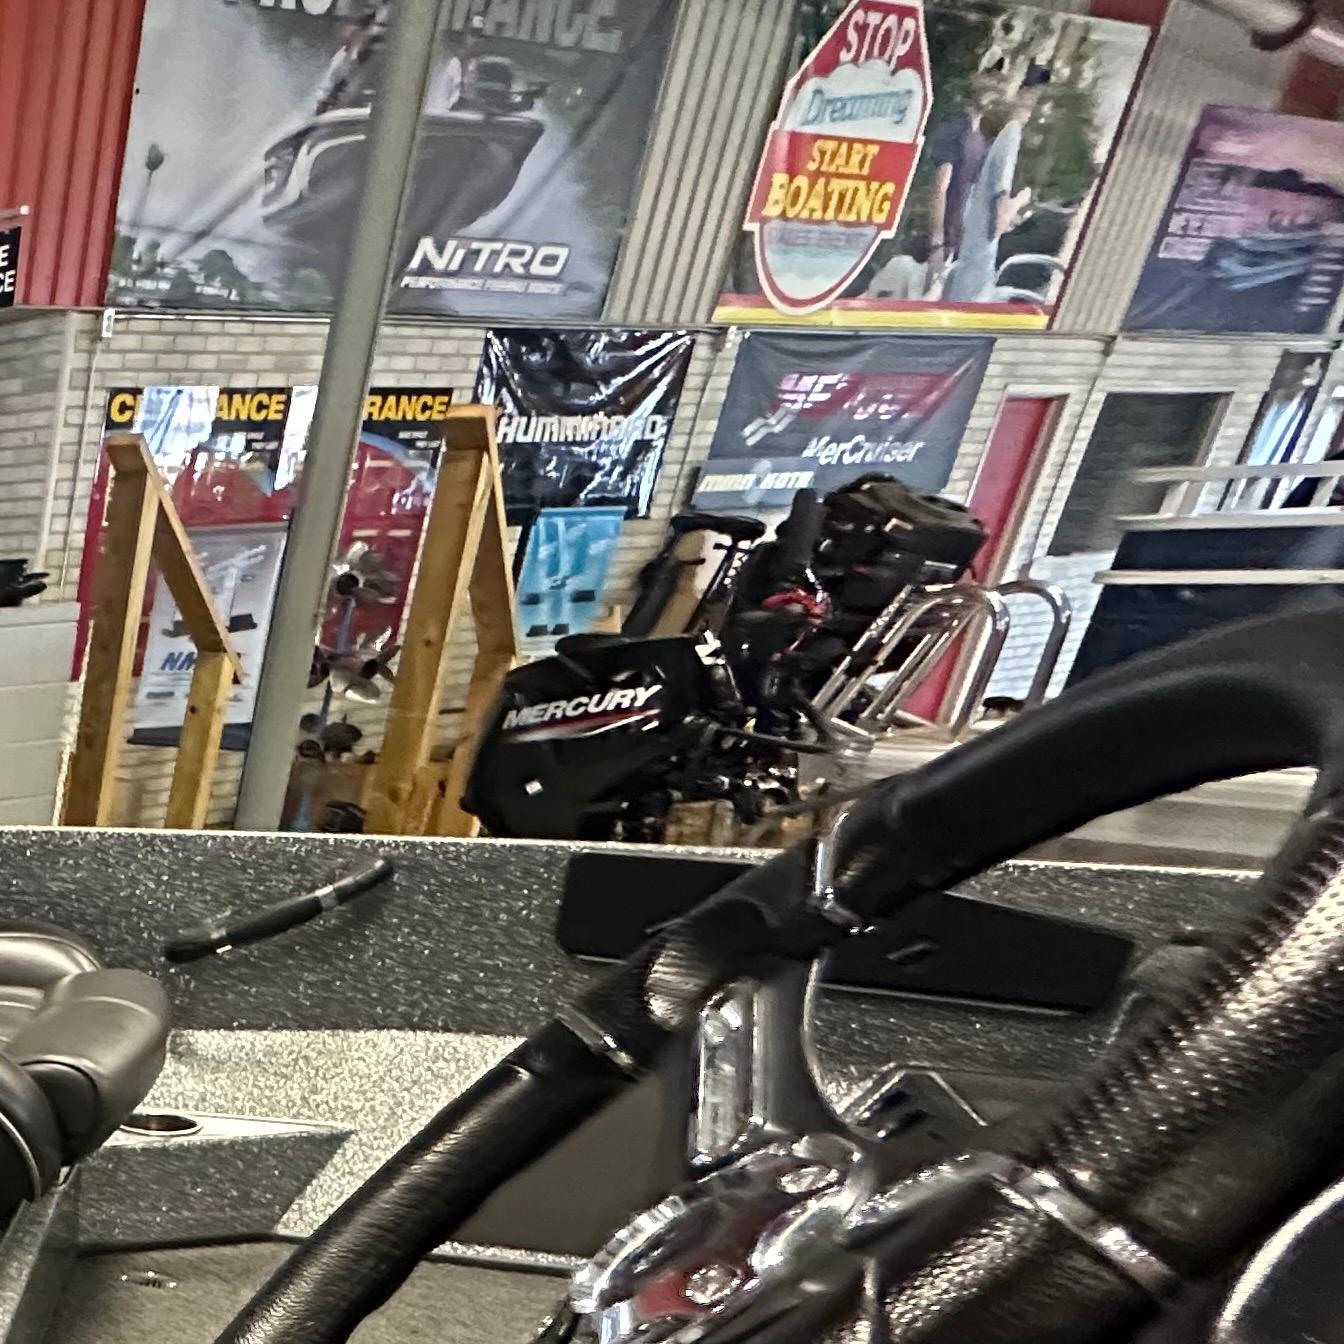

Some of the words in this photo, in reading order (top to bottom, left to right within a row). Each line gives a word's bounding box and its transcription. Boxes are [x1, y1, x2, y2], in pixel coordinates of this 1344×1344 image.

[839, 9, 915, 72] STOP
[807, 139, 879, 175] START
[762, 172, 895, 223] BOATING
[502, 684, 663, 730] MERCURY
